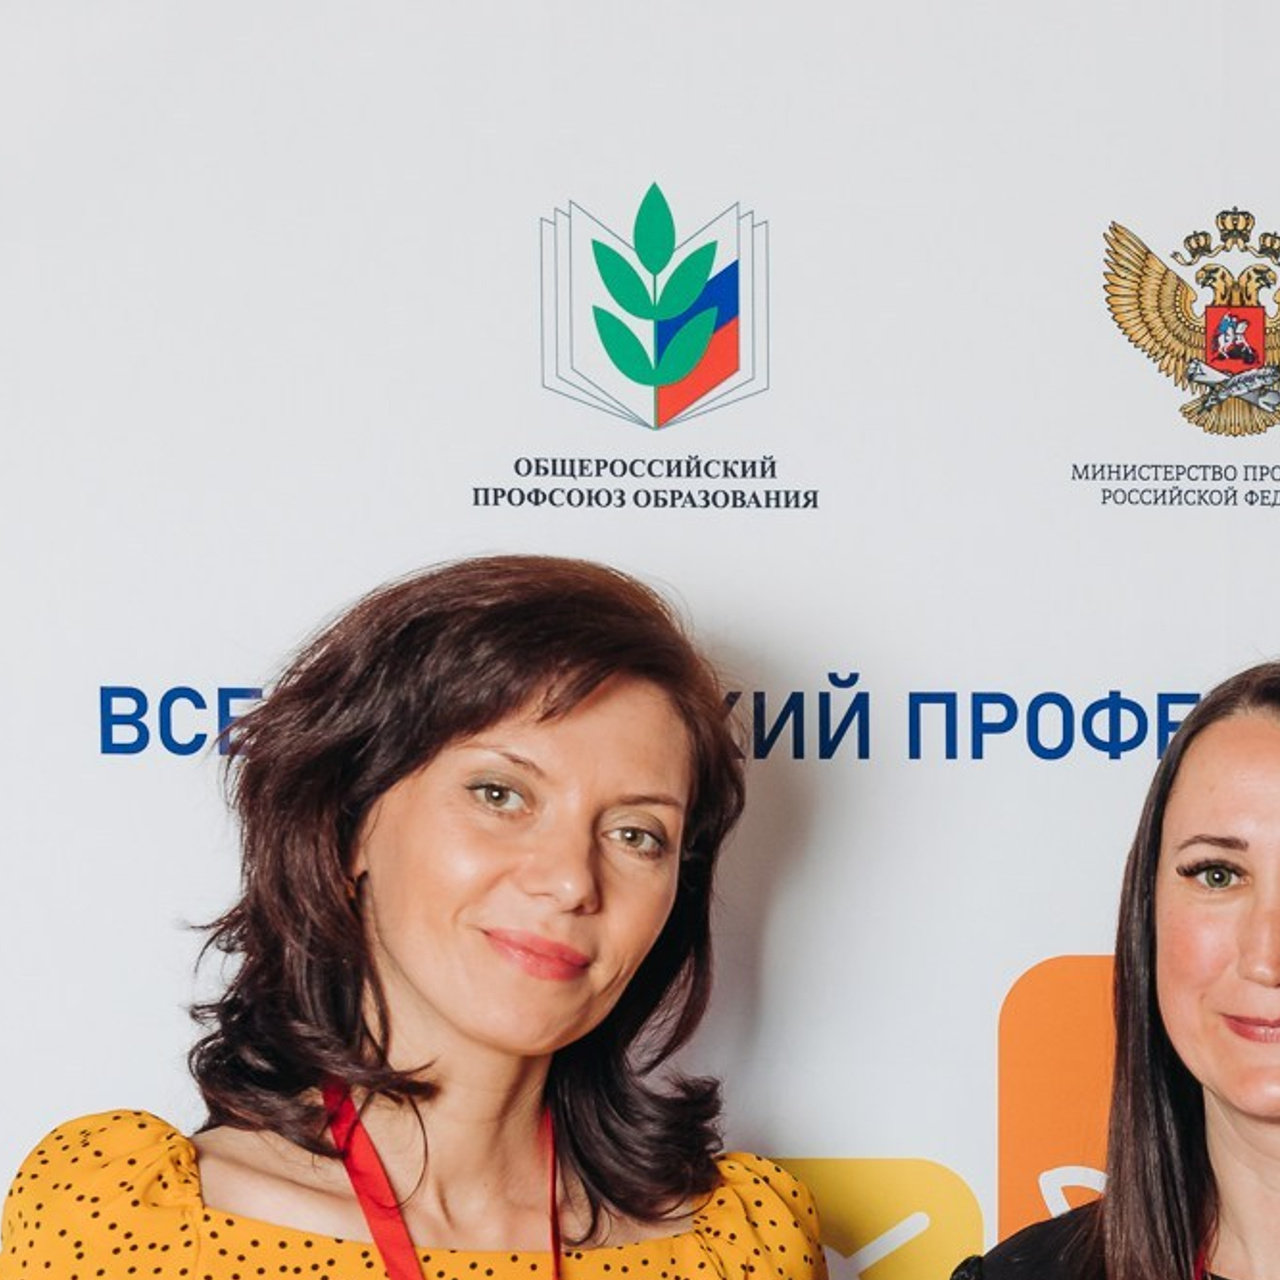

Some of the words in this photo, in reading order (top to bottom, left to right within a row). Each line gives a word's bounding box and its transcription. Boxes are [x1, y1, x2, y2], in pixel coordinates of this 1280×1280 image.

[514, 455, 777, 480] ОБЩЕРОССИЙСКИЙ
[1072, 464, 1238, 481] МИНИСТЕРСТВО
[472, 487, 626, 508] ПРОФСОЮЗ
[633, 489, 819, 509] ОБРАЗОВАНИЯ
[1101, 486, 1238, 506] РОССИЙСКОЙ
